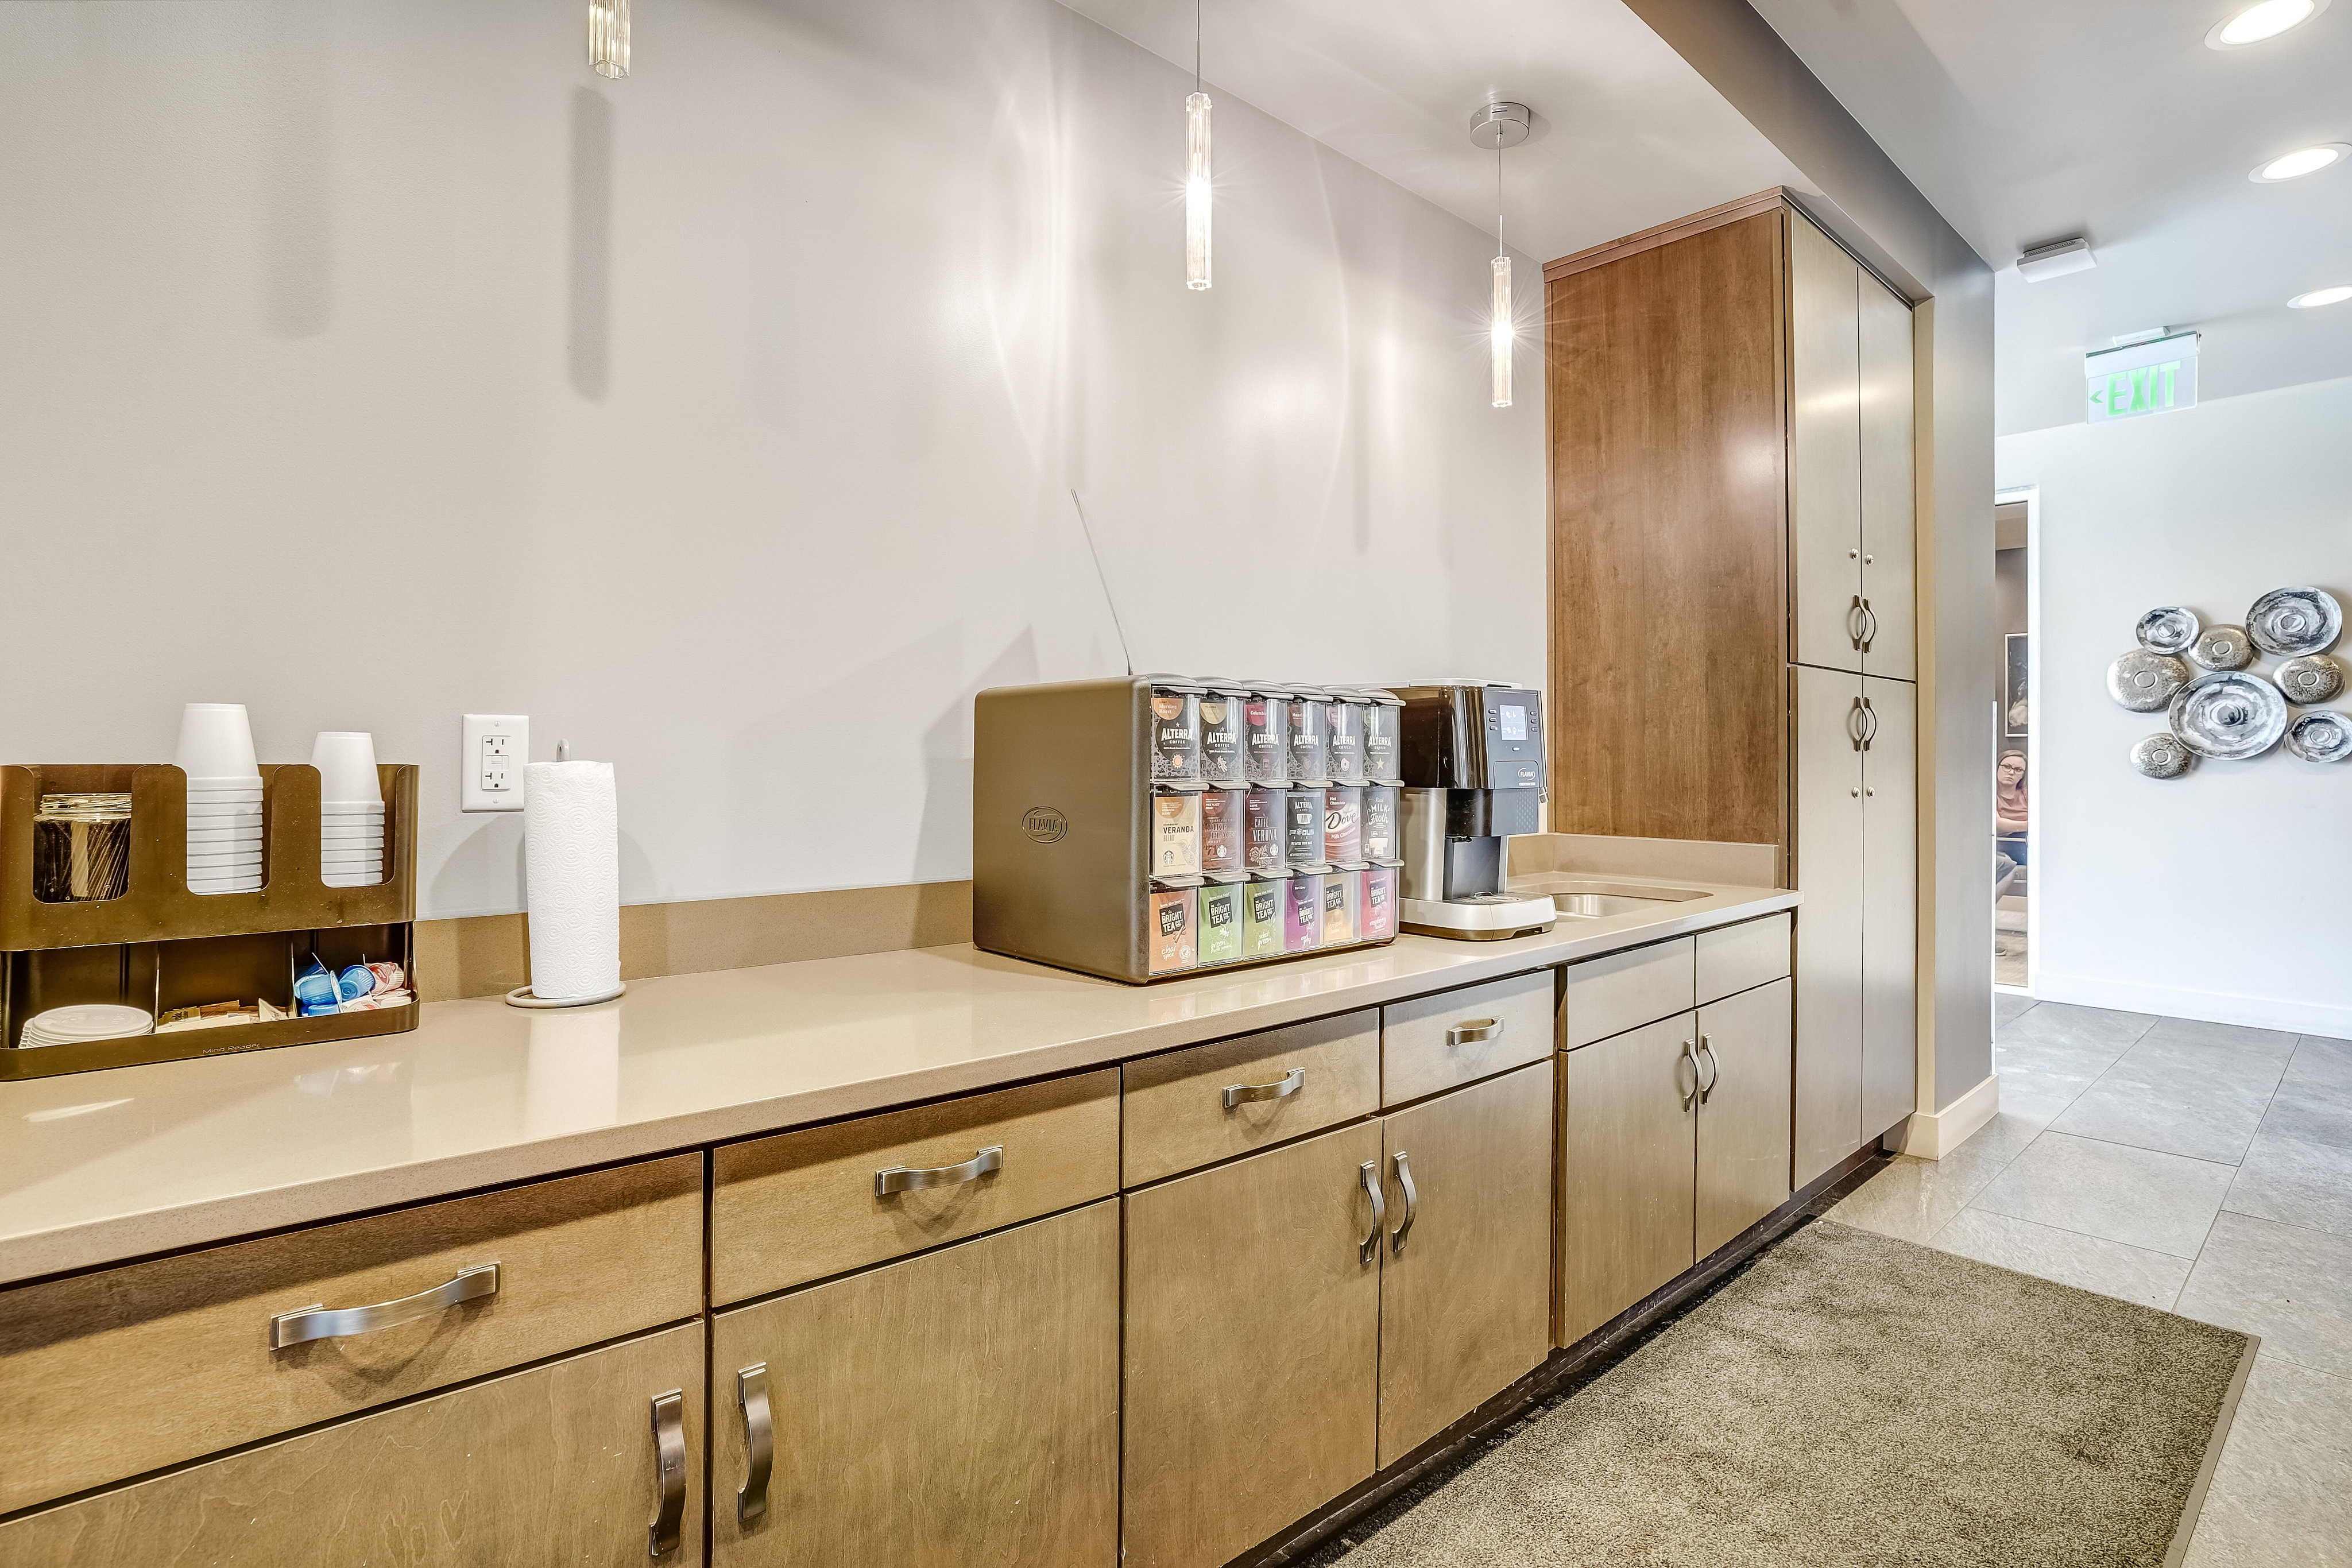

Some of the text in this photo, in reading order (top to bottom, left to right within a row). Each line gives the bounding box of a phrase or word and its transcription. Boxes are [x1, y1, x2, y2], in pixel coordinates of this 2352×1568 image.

[2107, 360, 2181, 417] EXIT
[1160, 728, 1193, 741] ALTERRA
[1206, 732, 1237, 745] ALTERRA
[1252, 733, 1279, 746] ALTERRA
[1293, 734, 1319, 746] ALTERRA
[1332, 735, 1356, 747] ALTERRA
[1368, 735, 1391, 747] ALTERRA
[1371, 803, 1388, 813] MILK
[1368, 812, 1389, 826] Froth
[1028, 818, 1059, 833] FLAVIA
[1163, 826, 1194, 834] VERANDA
[1206, 823, 1228, 831] PIKE
[1211, 831, 1236, 839] PLACE
[1253, 828, 1277, 842] VERONA
[1326, 890, 1342, 901] BRIGHT
[1371, 886, 1386, 897] BRIGHT
[1255, 899, 1274, 912] BRIGHT
[1326, 900, 1337, 909] TEA
[1372, 896, 1380, 905] TEA
[1210, 903, 1231, 916] BRIGHT
[1256, 909, 1267, 920] TEA
[1299, 907, 1313, 917] BRIGHT
[1161, 911, 1183, 924] BRIGHT
[1212, 914, 1224, 924] TEA
[1299, 915, 1309, 923] TEA
[1163, 922, 1175, 933] TEA
[1161, 943, 1177, 955] chai
[1258, 938, 1272, 951] green
[1163, 952, 1175, 961] spice
[227, 1043, 260, 1051] Reader
